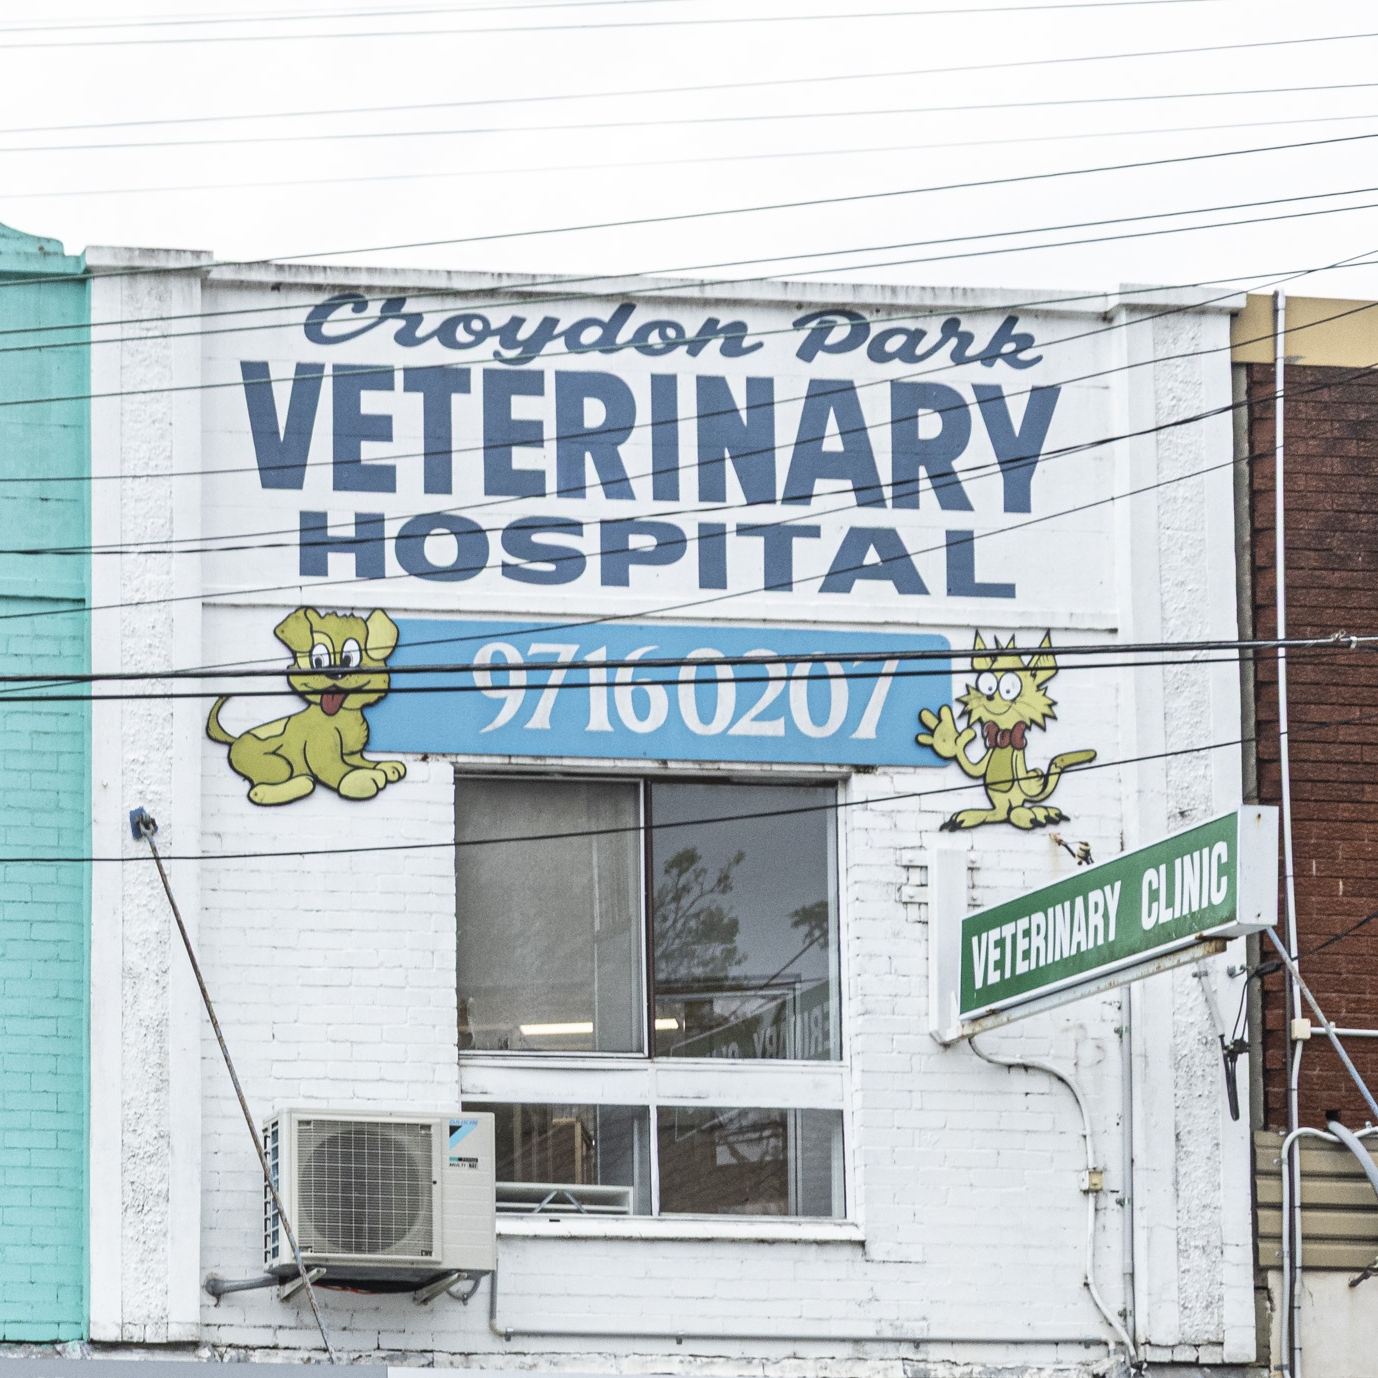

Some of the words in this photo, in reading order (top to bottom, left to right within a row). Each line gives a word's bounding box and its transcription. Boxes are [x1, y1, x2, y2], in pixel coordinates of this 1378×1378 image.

[302, 292, 764, 366] Croydon
[792, 307, 1047, 372] Park
[240, 360, 1062, 514] VETERINARY
[298, 510, 1018, 600] HOSPITAL
[971, 880, 1122, 989] VETERINARY
[1141, 841, 1228, 931] CLINIC
